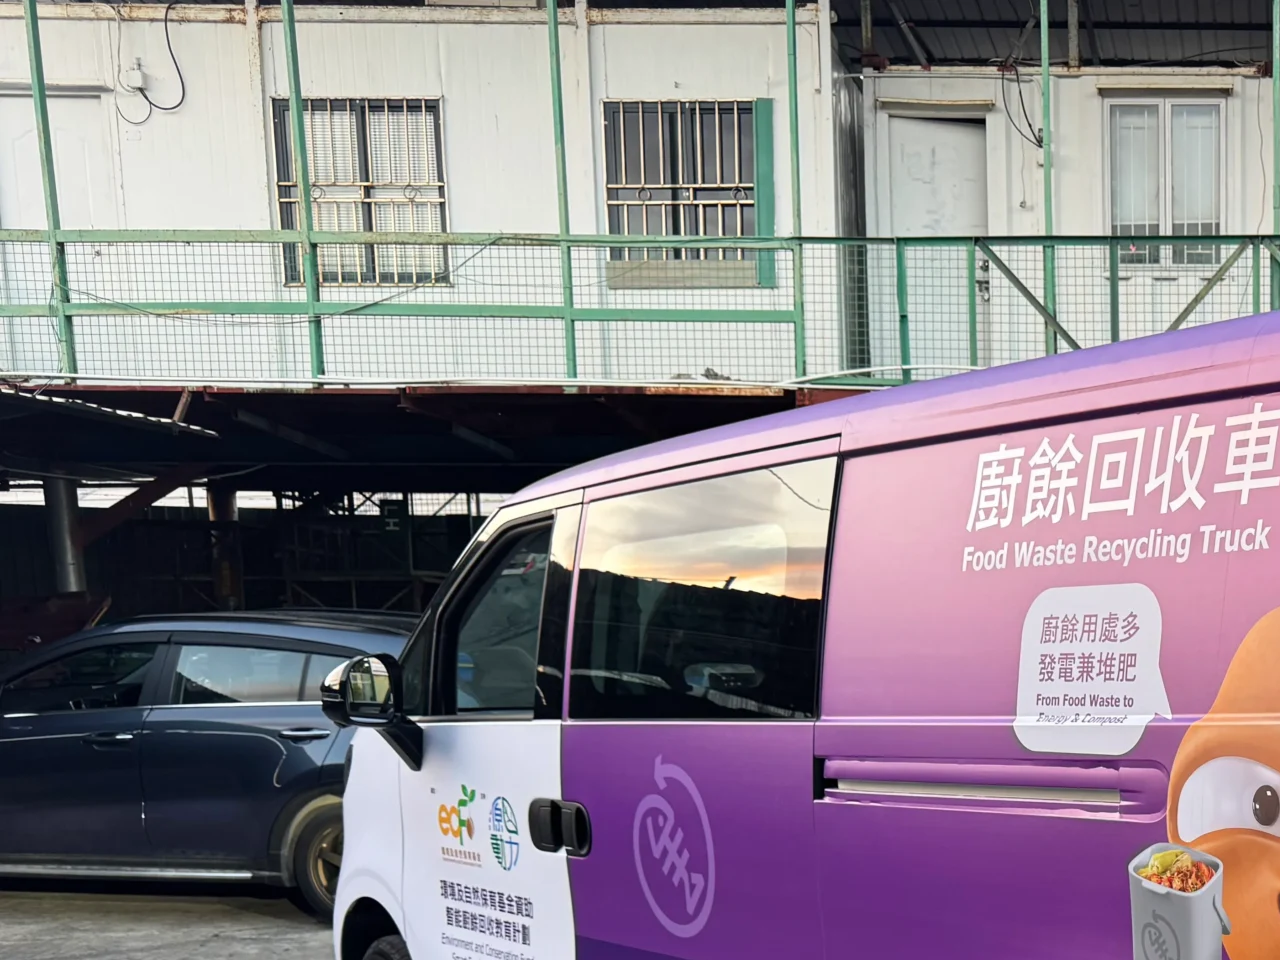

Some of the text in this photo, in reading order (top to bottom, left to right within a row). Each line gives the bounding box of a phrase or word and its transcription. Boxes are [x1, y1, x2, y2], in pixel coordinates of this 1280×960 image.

[962, 519, 1272, 571] Food Waste Recycling Truck
[1040, 611, 1140, 644] 廚餘用處多
[1038, 652, 1137, 683] 發電兼堆肥
[1036, 693, 1134, 708] From Food Waste to
[1036, 712, 1128, 726] Energy & Compost
[441, 932, 474, 952] Environment
[475, 943, 484, 954] and
